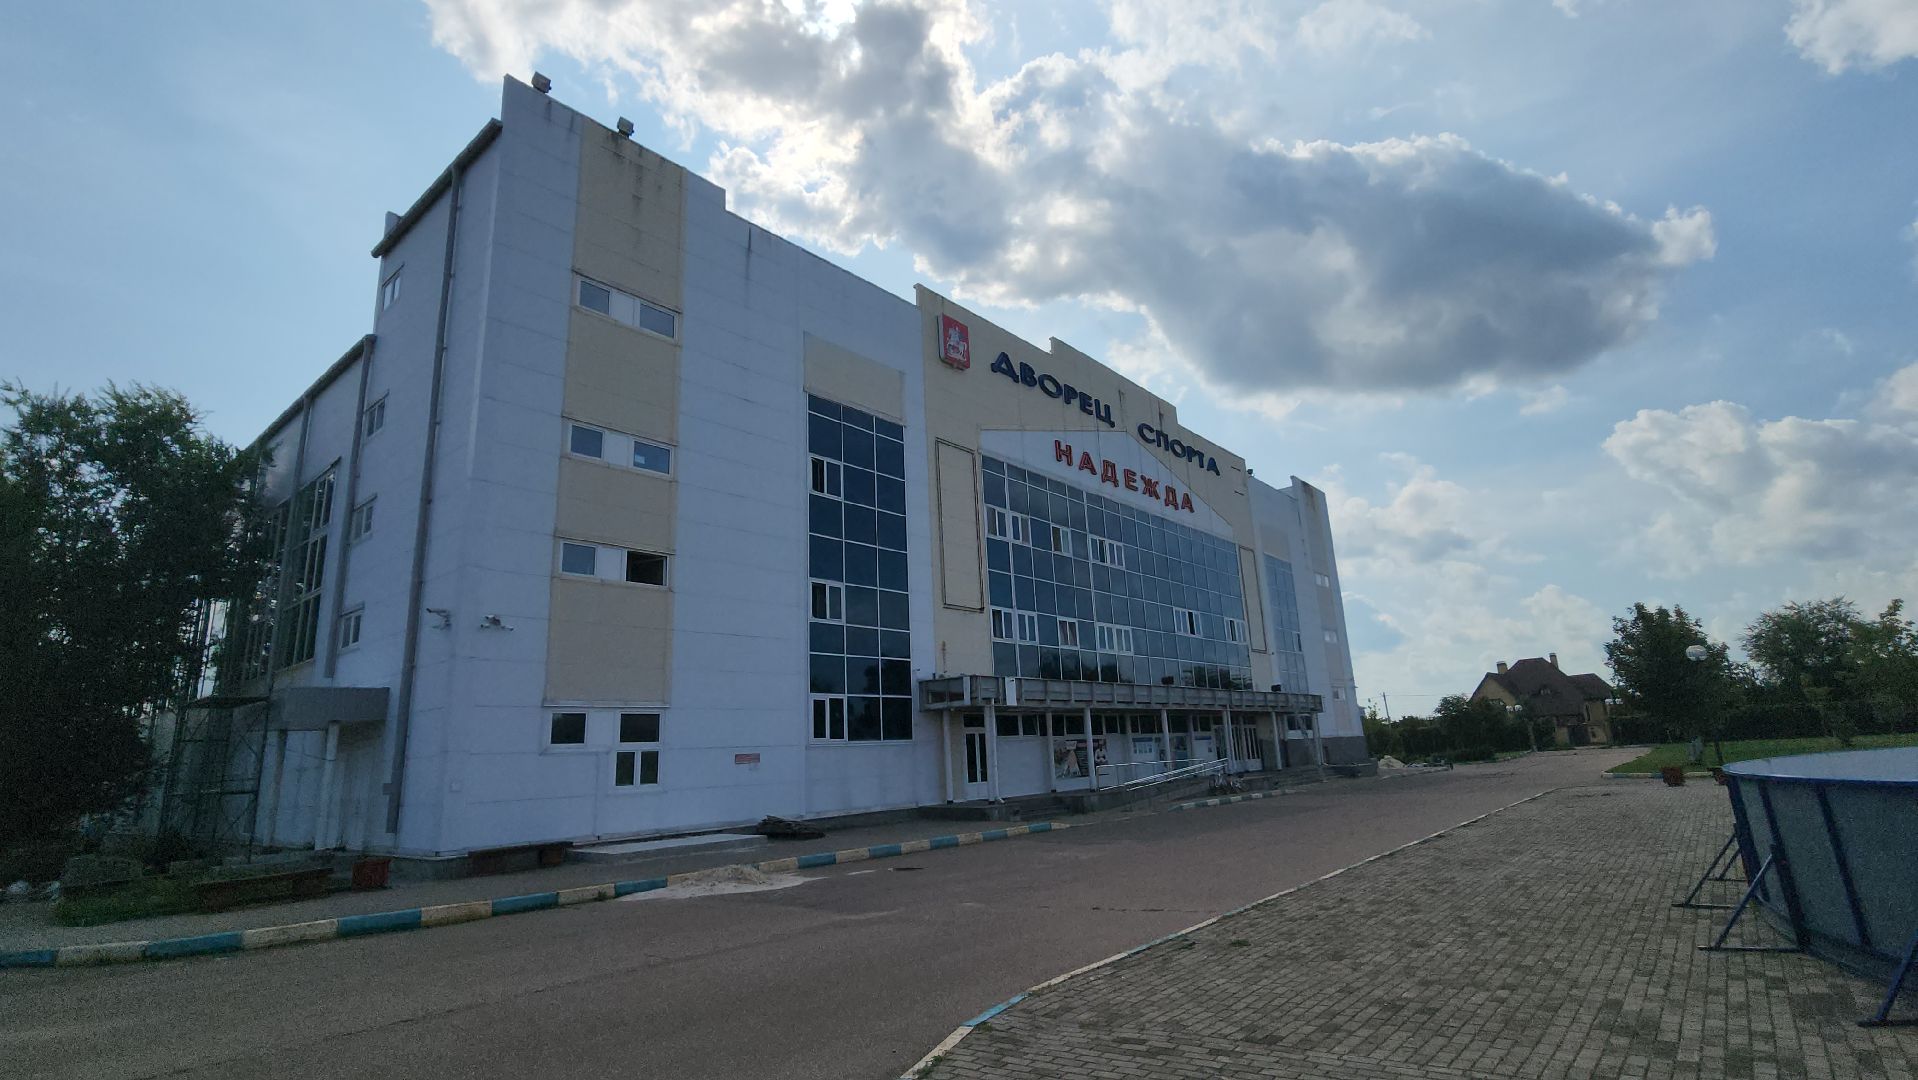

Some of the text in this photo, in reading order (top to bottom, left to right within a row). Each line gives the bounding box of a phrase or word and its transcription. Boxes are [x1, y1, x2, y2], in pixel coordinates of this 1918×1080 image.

[990, 351, 1220, 476] ДВОРЕЦ СПОРТА
[1054, 439, 1195, 513] НАДЕЖДА
